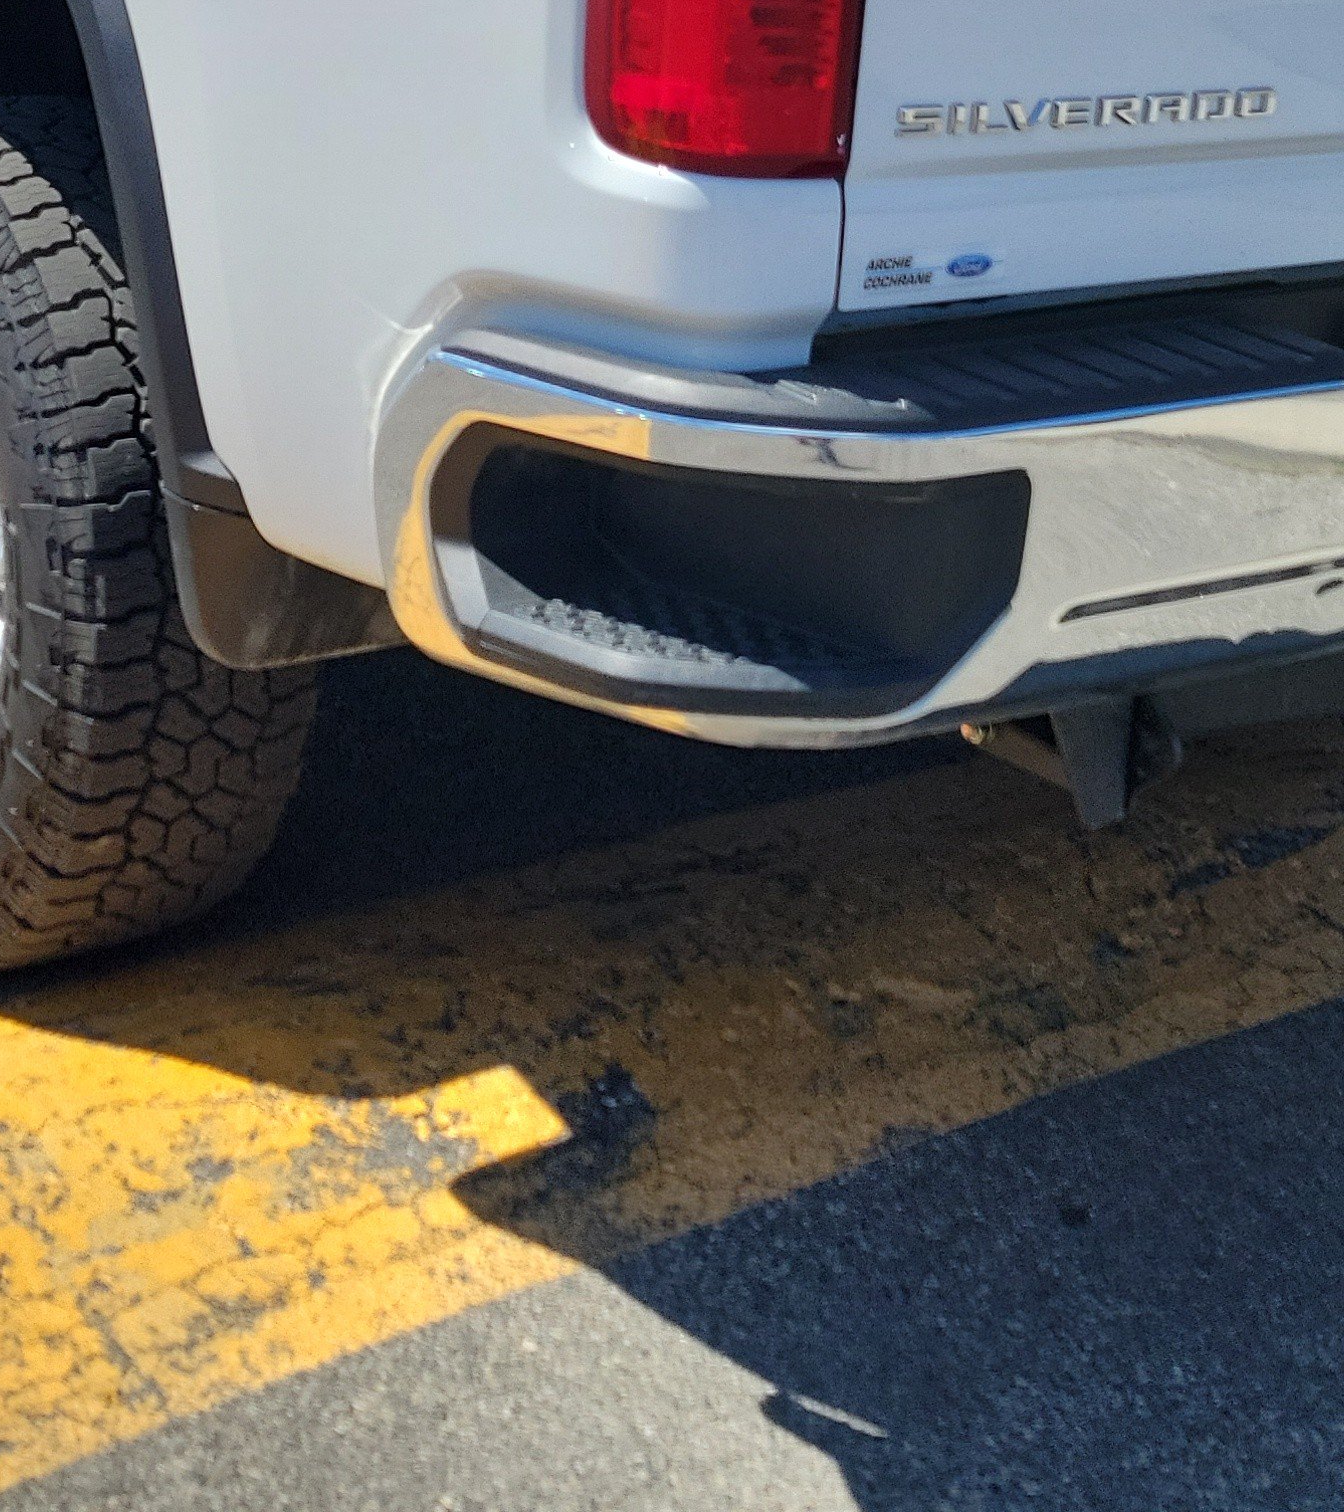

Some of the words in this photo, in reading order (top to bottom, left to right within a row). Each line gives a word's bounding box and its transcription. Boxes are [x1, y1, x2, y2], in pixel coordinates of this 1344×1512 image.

[895, 86, 1278, 137] SILVERADO
[866, 256, 913, 271] ARCHIE
[864, 272, 933, 289] COCHRANE
